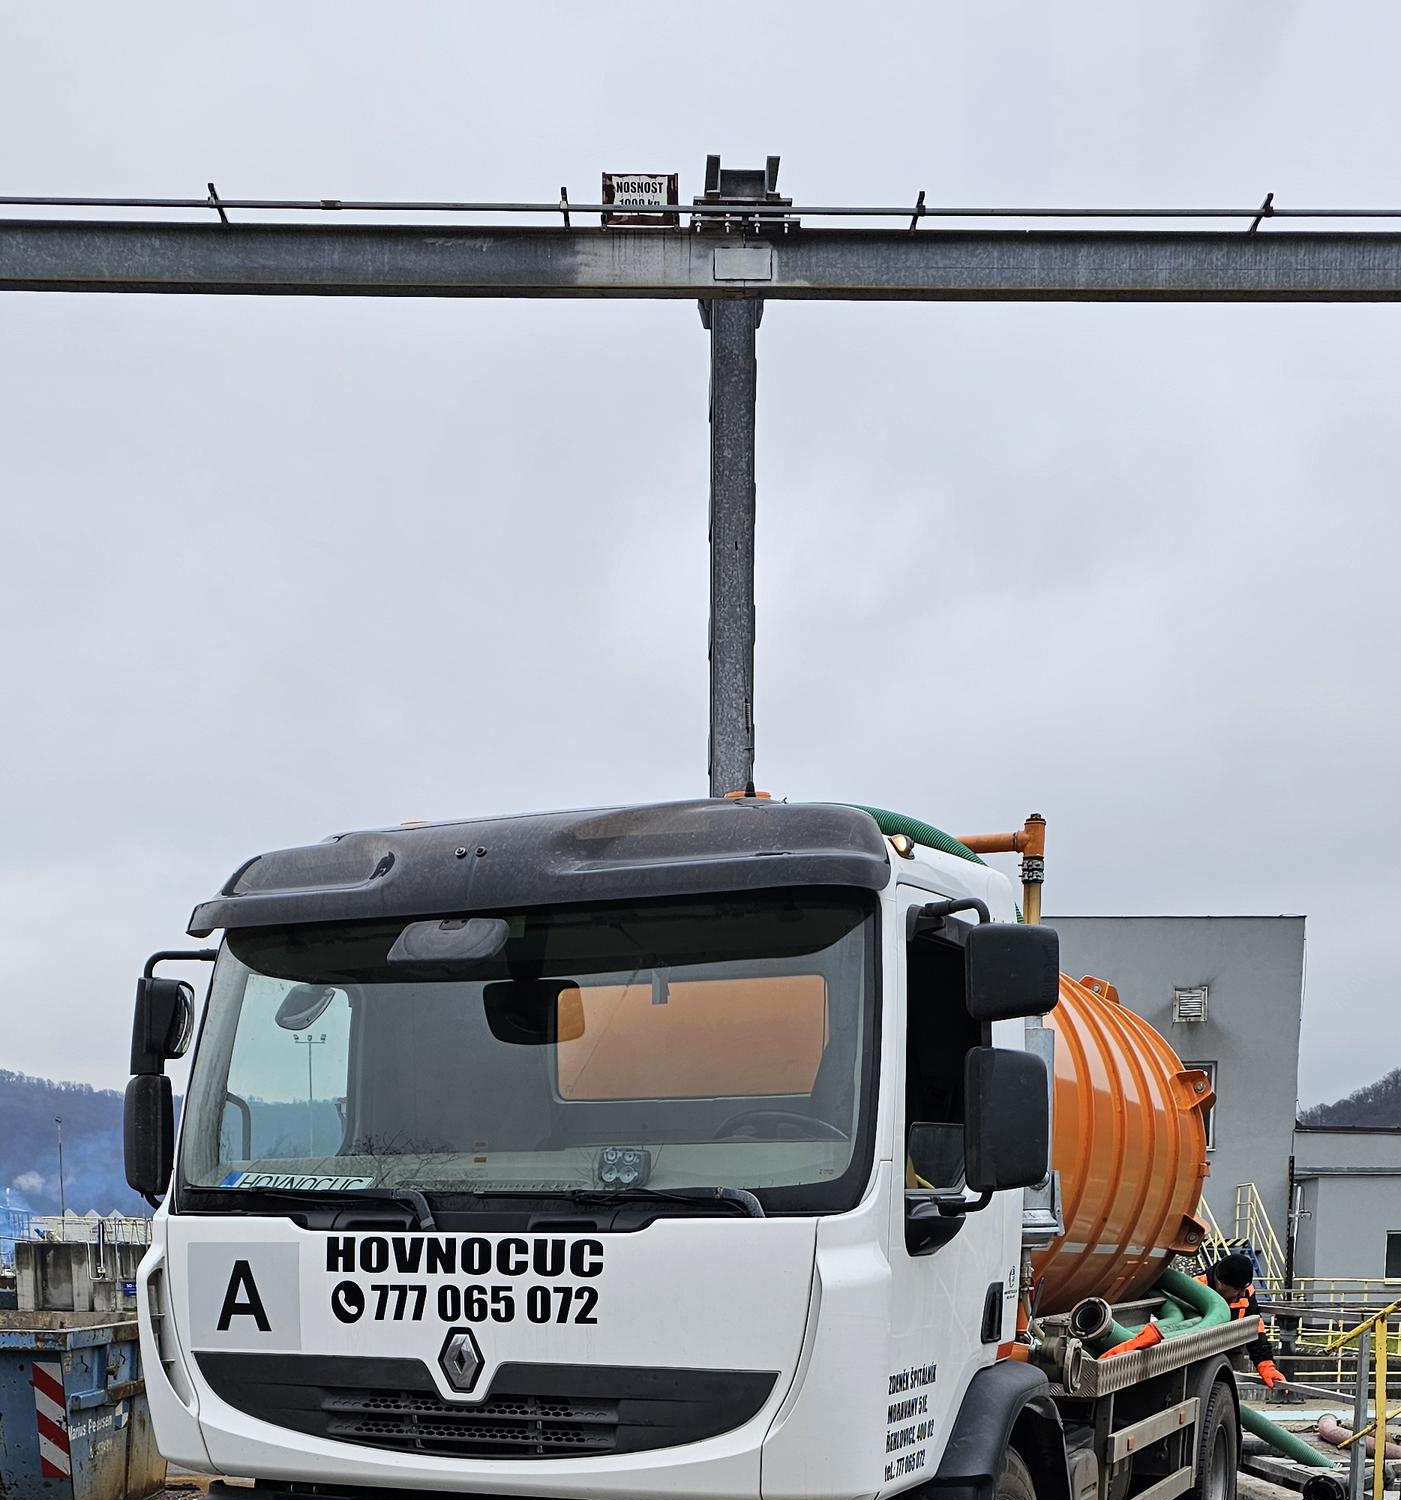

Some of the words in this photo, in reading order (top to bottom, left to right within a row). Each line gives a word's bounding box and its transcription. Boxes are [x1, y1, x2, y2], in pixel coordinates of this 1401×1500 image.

[616, 181, 664, 194] NOSNOST
[326, 1236, 605, 1278] HOVNOCUC
[216, 1259, 272, 1332] A
[370, 1283, 428, 1322] 777
[437, 1285, 515, 1324] 065
[525, 1286, 599, 1325] 072
[888, 1369, 910, 1396] ZDENĚK
[886, 1397, 919, 1425] MORAVANY
[916, 1421, 927, 1441] 400
[927, 1418, 935, 1438] 02
[884, 1460, 895, 1482] tel.:
[896, 1456, 905, 1478] 777
[904, 1452, 916, 1474] 065
[916, 1448, 926, 1469] 072
